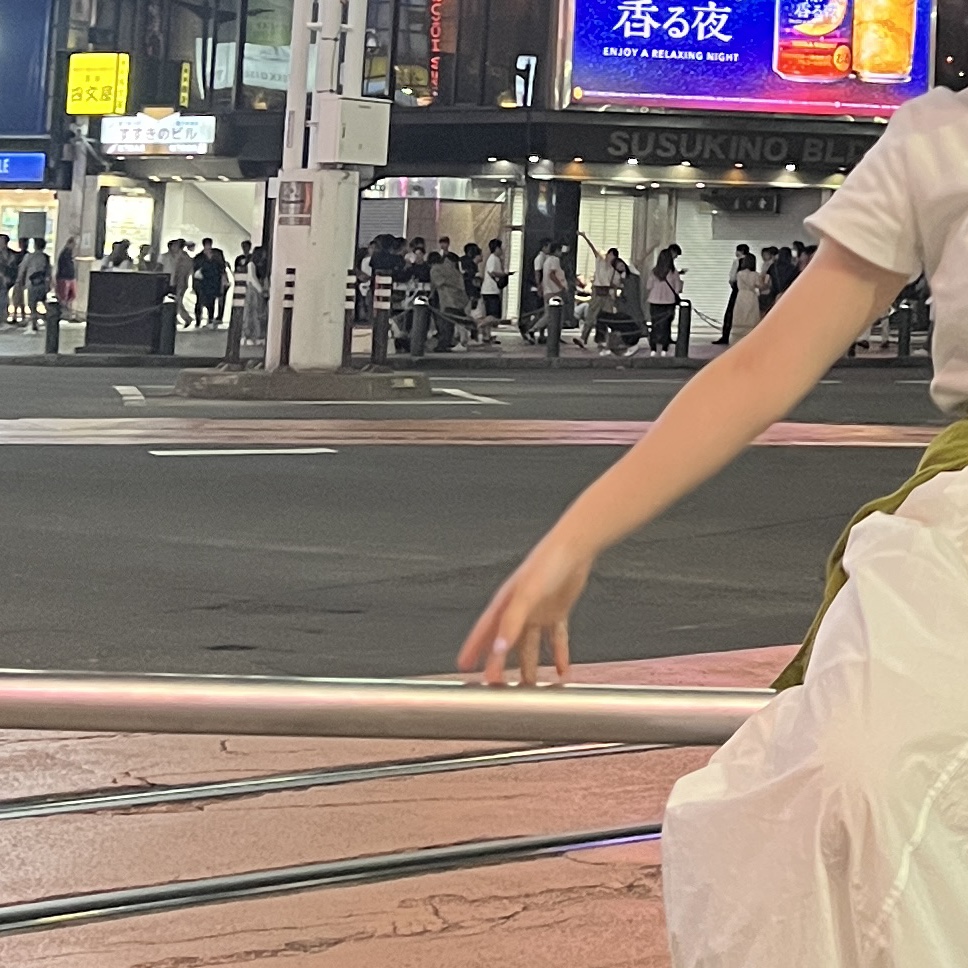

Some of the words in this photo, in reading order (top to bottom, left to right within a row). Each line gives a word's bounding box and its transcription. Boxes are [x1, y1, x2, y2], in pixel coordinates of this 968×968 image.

[612, 0, 733, 43] 香る夜
[602, 47, 639, 57] ENJOY
[640, 49, 649, 58] A
[651, 49, 704, 61] RELAXING
[706, 51, 739, 62] NIGHT
[119, 127, 199, 140] すすきのビル
[607, 130, 790, 162] SUSUKINO
